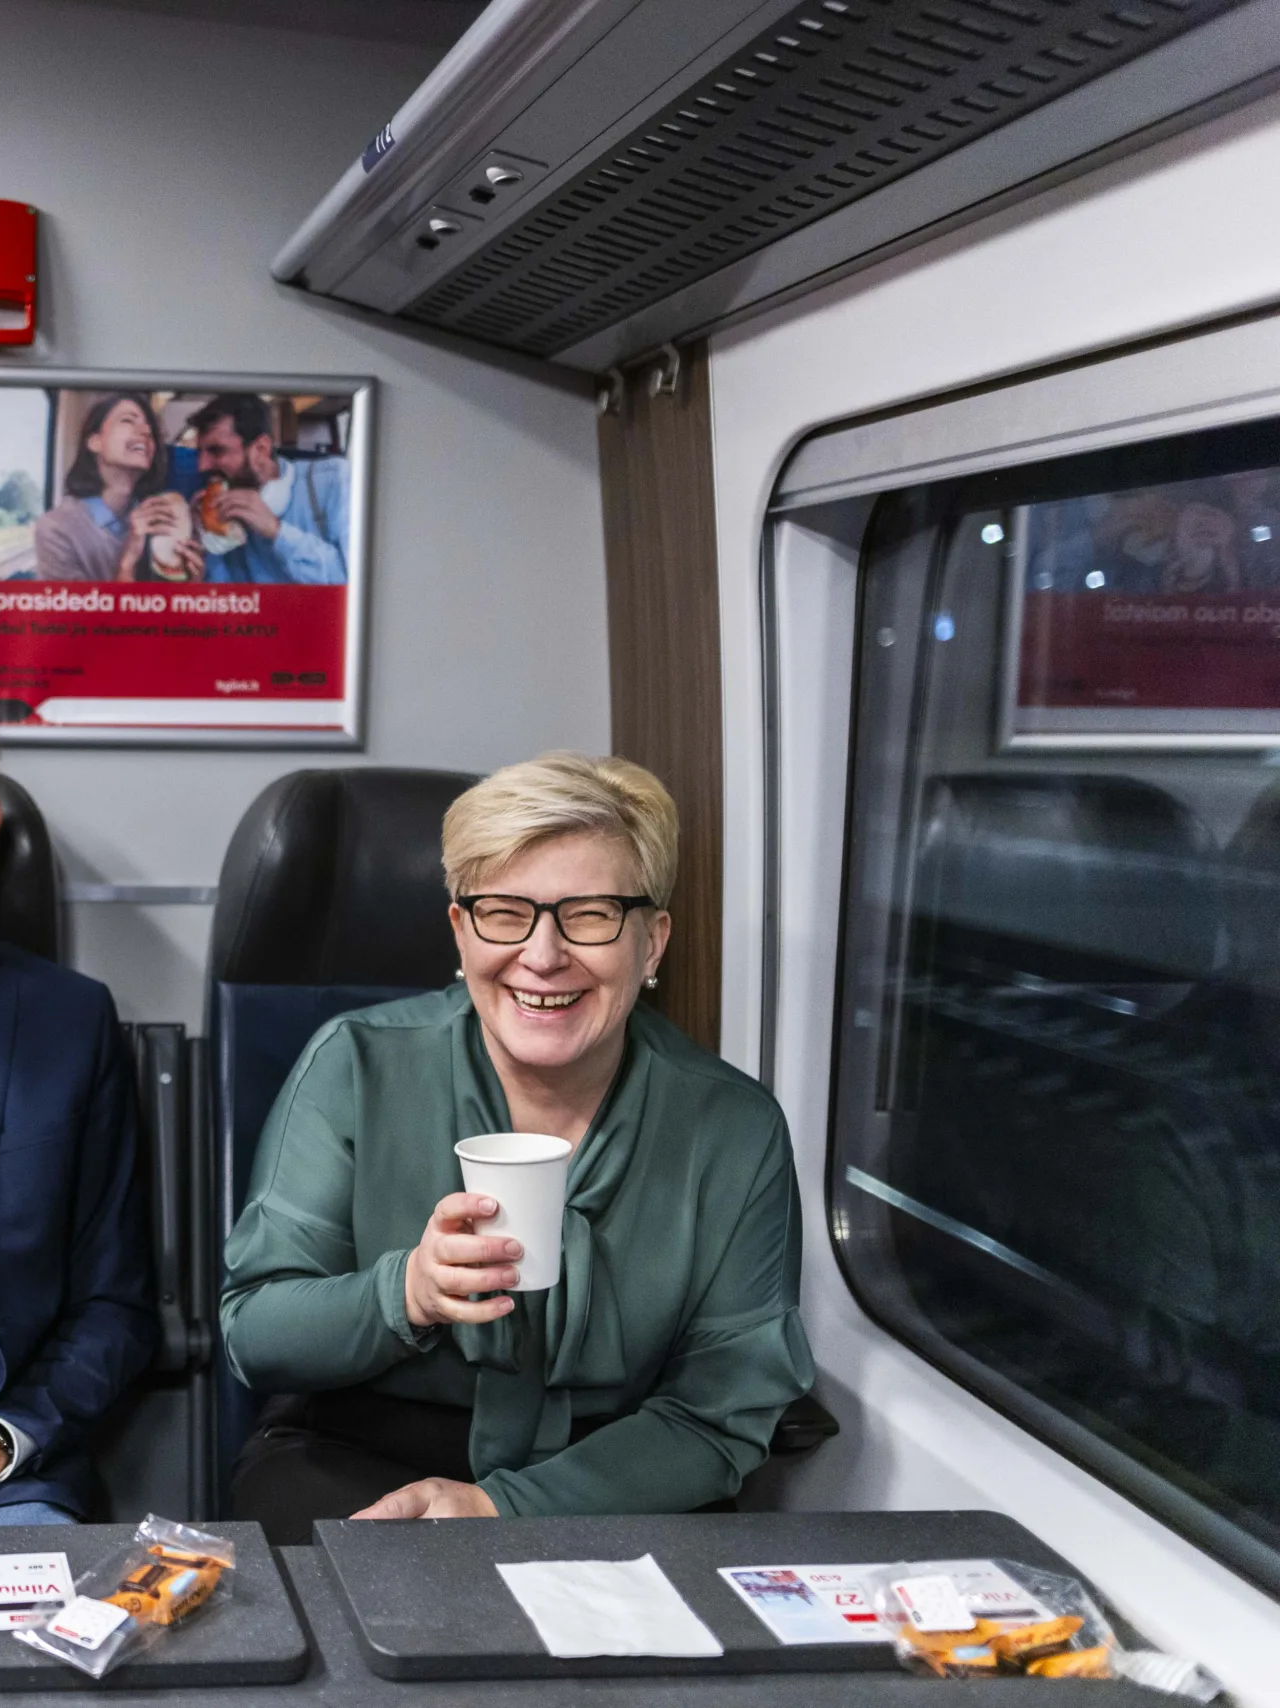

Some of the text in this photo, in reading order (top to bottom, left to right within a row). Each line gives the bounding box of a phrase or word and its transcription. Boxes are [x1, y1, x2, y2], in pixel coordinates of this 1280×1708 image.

[120, 594, 167, 613] nuo
[171, 589, 261, 614] maisto!
[835, 1593, 864, 1606] 27
